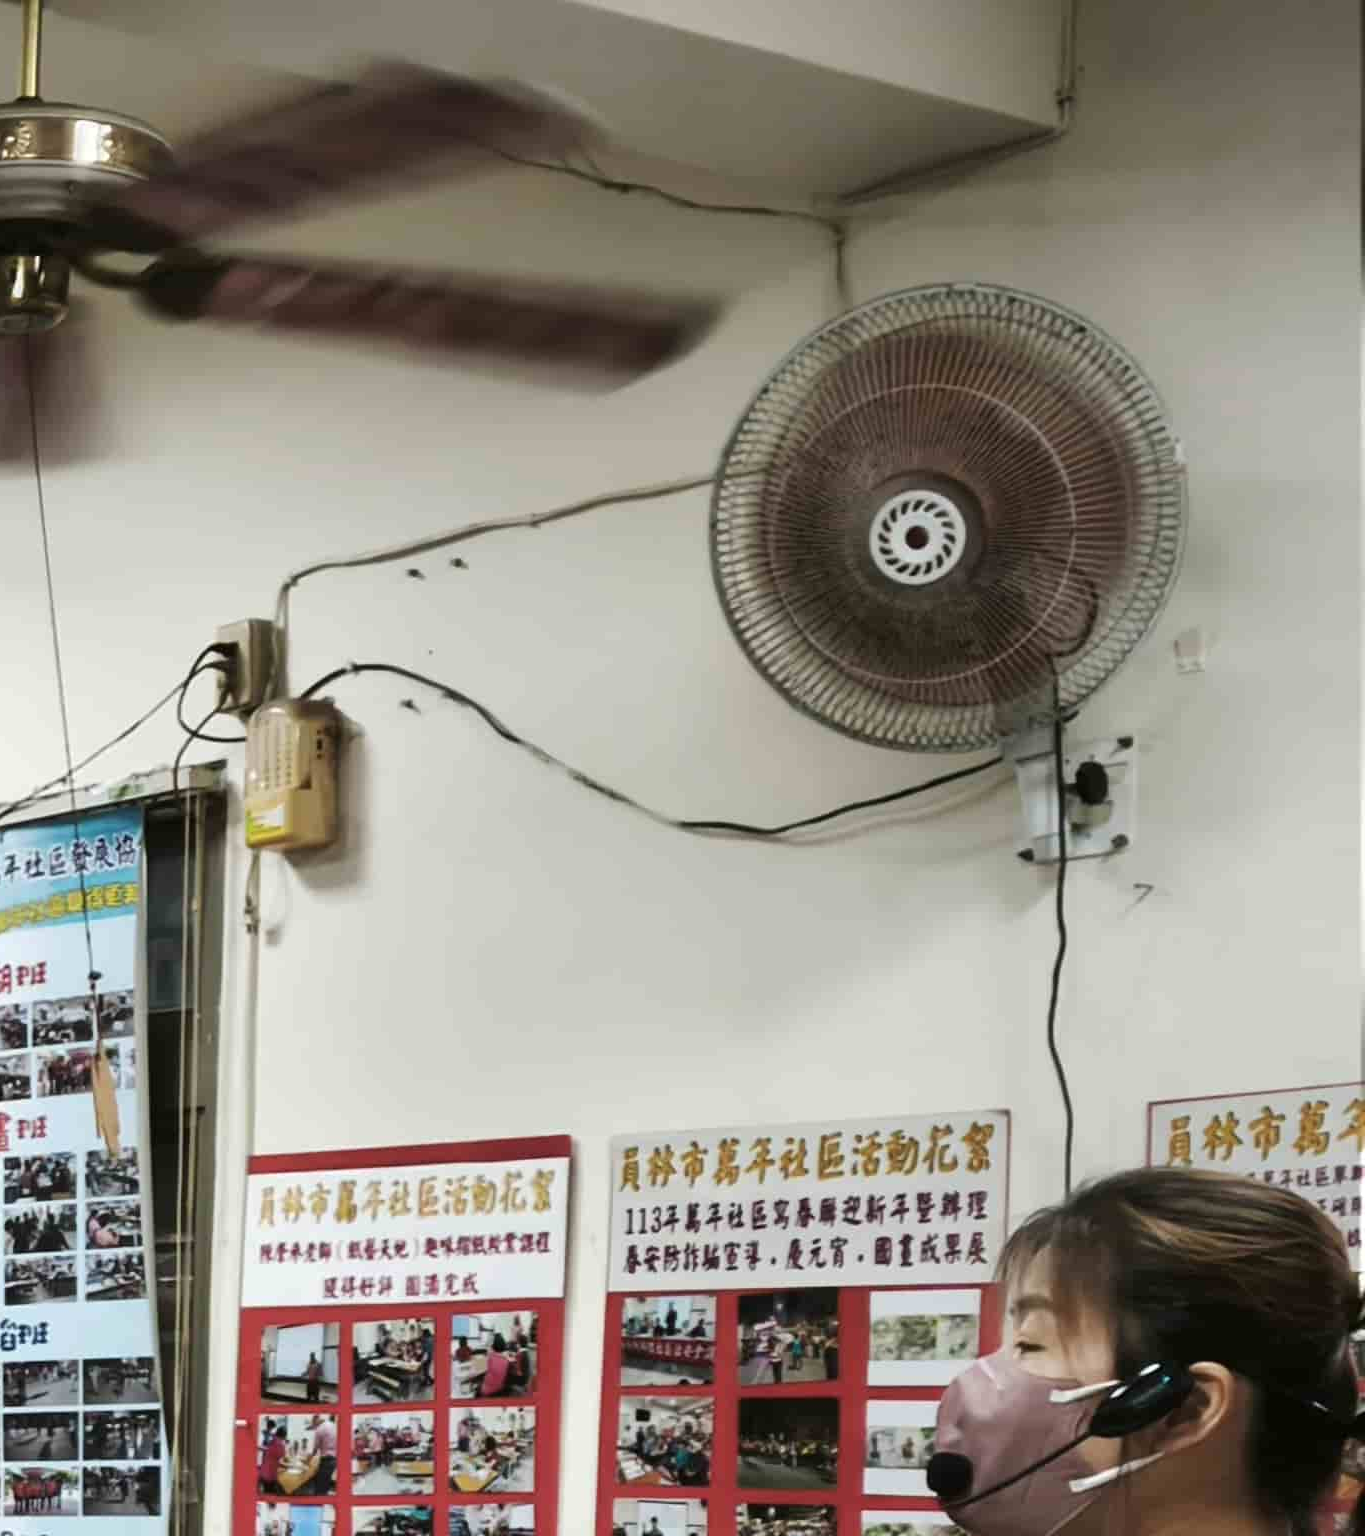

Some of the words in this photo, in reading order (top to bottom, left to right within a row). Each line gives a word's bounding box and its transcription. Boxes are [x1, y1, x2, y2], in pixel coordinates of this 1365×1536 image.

[618, 1120, 996, 1192] 員林市萬年社區活動花絮
[259, 1168, 556, 1226] 員林市萬年社區活動花絮
